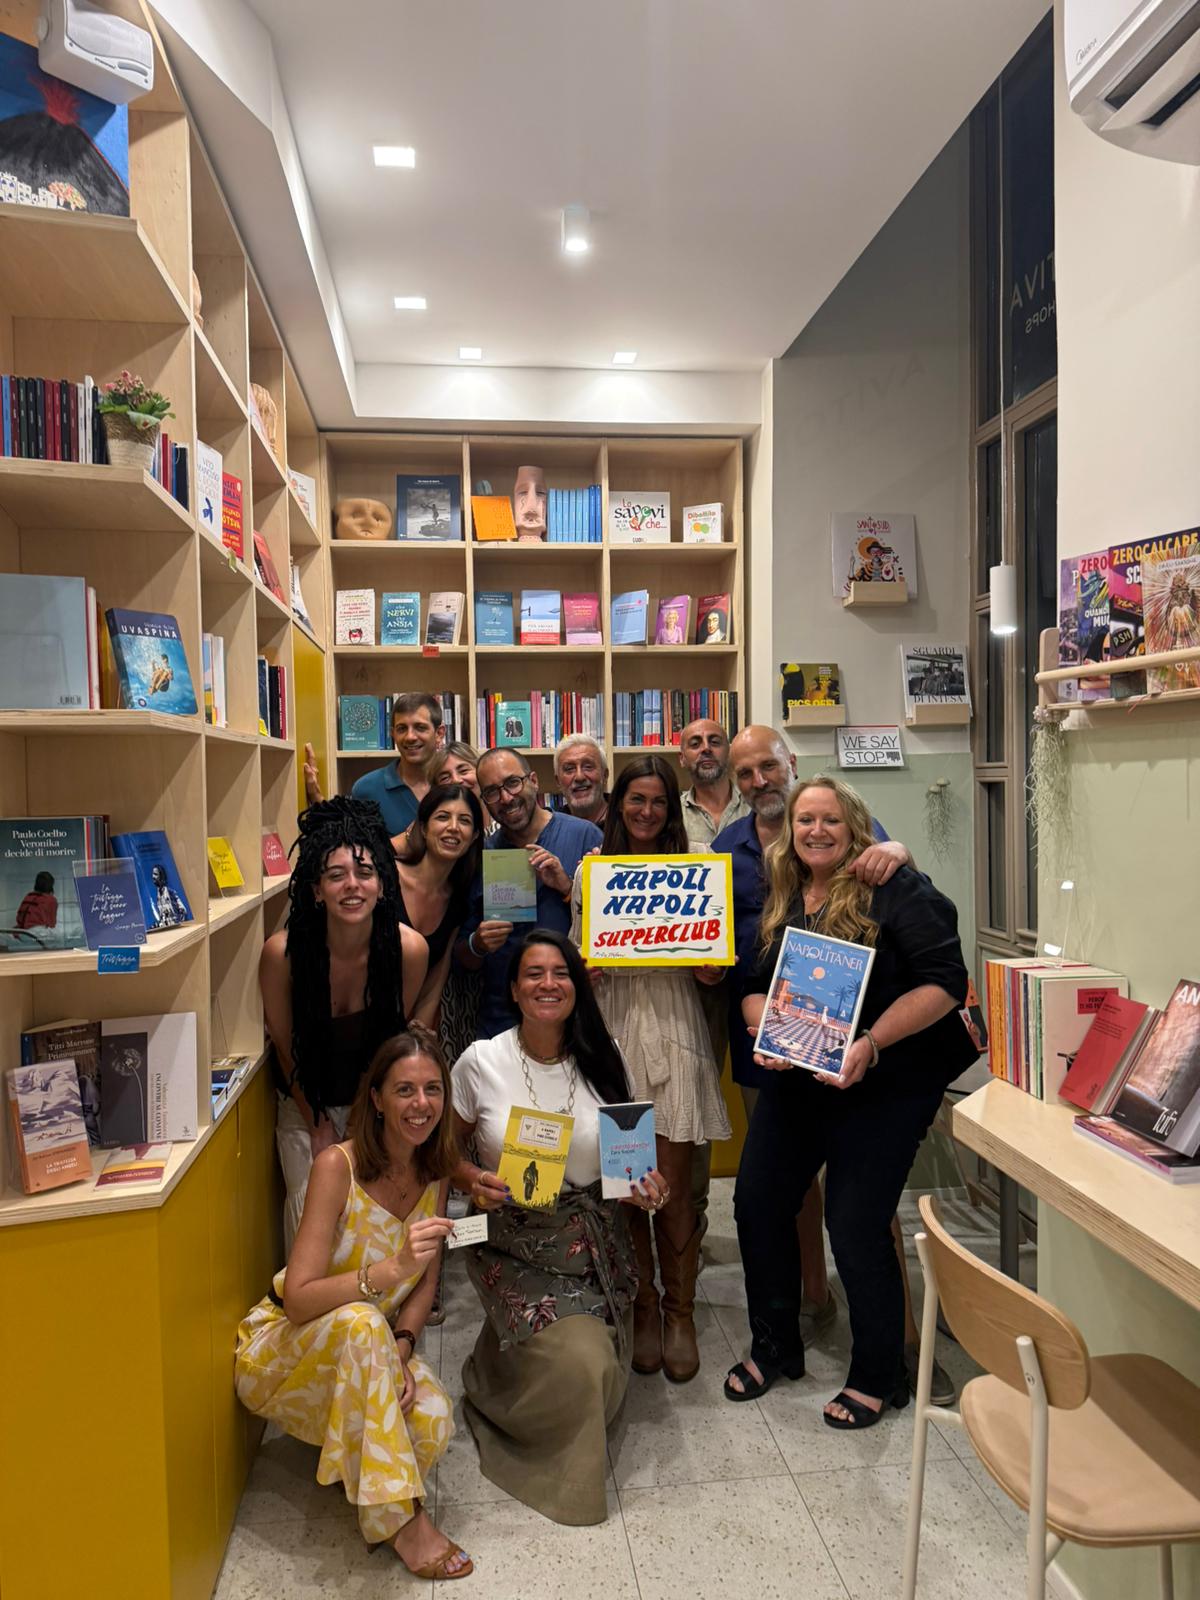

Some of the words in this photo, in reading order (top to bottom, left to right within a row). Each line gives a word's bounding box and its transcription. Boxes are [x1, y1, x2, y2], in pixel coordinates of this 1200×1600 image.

[1112, 532, 1198, 565] ZEROCALCARE
[121, 625, 178, 638] UVASPINA
[912, 646, 956, 656] SGUARDI
[842, 736, 866, 749] WE
[870, 736, 898, 749] SAY
[12, 830, 37, 839] Paulo
[37, 829, 68, 839] Coelho
[20, 839, 60, 848] Veronika
[4, 849, 33, 857] decide
[35, 849, 44, 857] di
[46, 848, 76, 856] morire
[606, 868, 711, 891] NAPOLI
[603, 894, 713, 917] NAPOLI
[593, 918, 721, 948] SUPPERCLUB
[786, 940, 864, 972] NAPOLITANER
